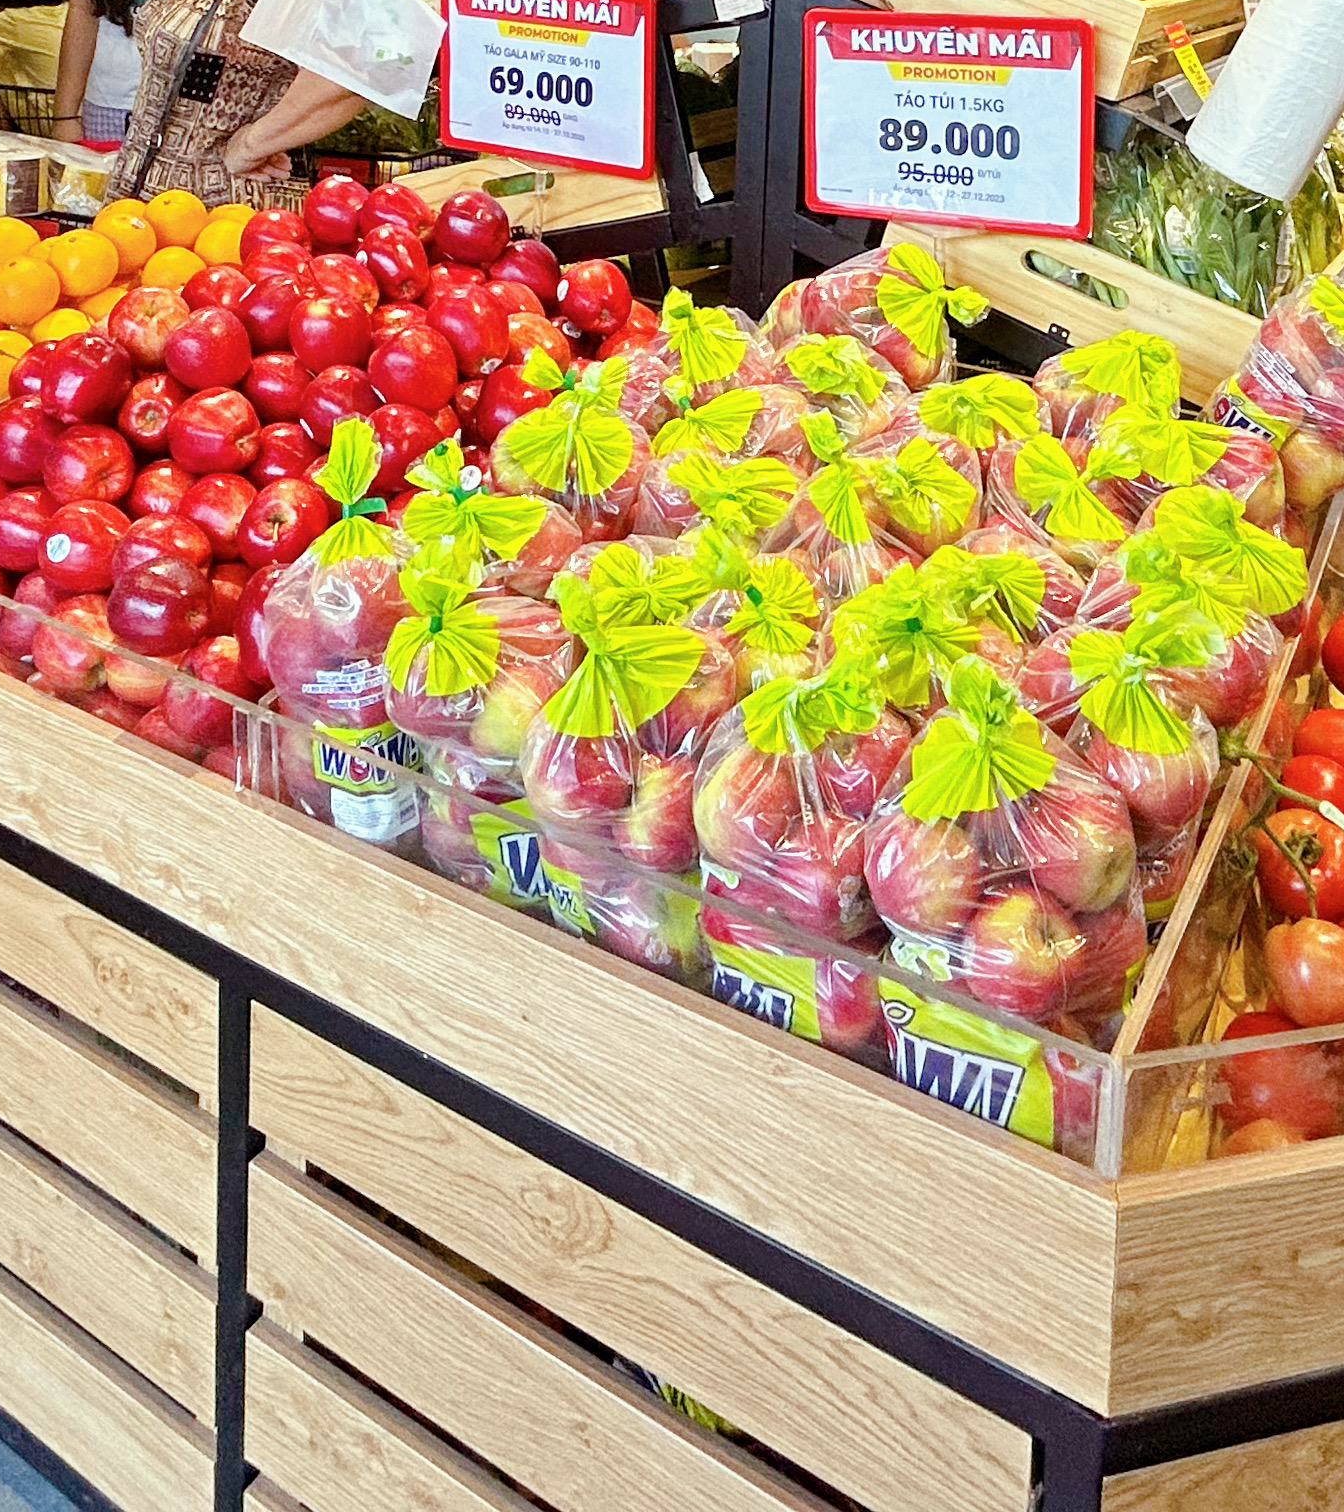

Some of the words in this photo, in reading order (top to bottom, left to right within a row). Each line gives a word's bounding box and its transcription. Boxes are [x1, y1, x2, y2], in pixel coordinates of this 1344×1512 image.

[509, 25, 578, 44] PROMOTION
[989, 29, 1051, 60] MÃI
[484, 43, 501, 56] TÁO
[504, 49, 528, 60] GALA
[530, 49, 546, 62] MỸ
[547, 53, 567, 66] SIZE
[569, 56, 601, 70] 90-110
[489, 66, 593, 107] 69.000
[903, 67, 996, 82] PROMOTION
[894, 90, 925, 108] TÁO
[929, 91, 955, 110] TÚI
[960, 97, 1004, 113] 1.5KG
[504, 103, 561, 126] 89.000
[879, 118, 1020, 160] 89.000
[898, 161, 974, 186] 95.000
